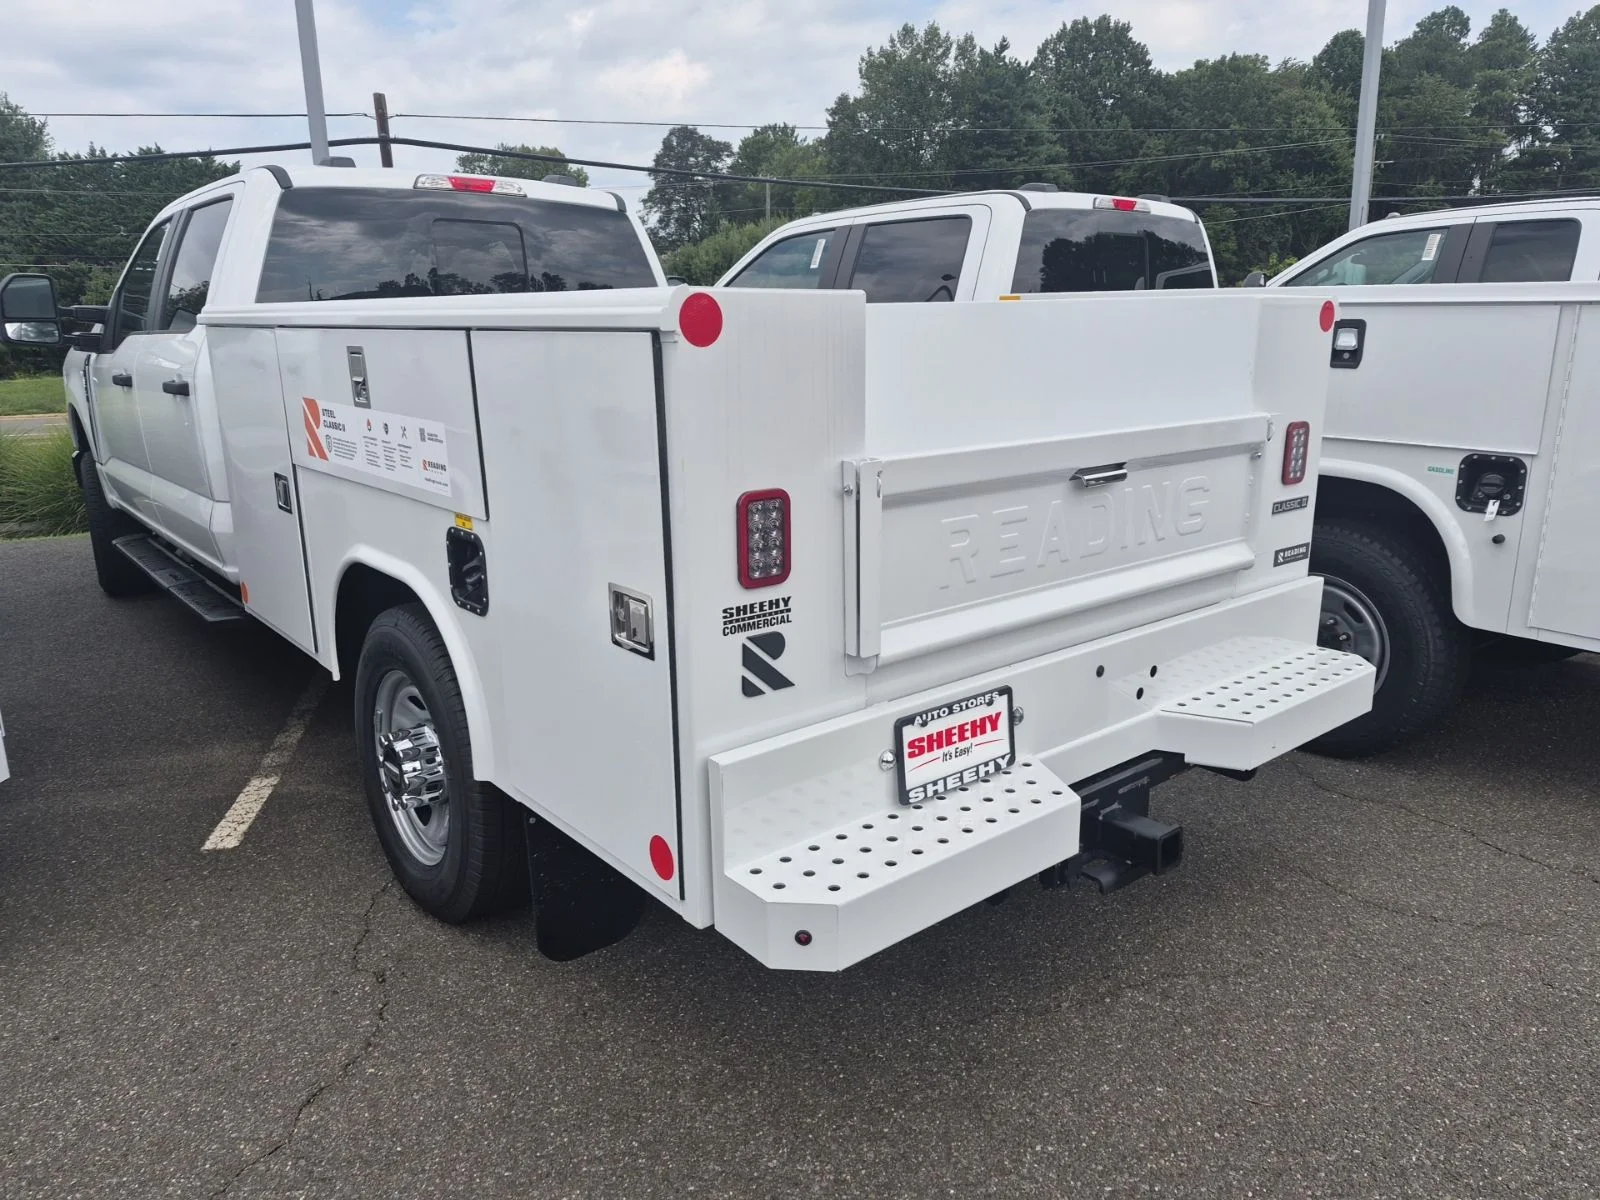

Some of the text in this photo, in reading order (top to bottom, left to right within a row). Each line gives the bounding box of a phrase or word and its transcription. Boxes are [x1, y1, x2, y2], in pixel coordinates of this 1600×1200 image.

[322, 408, 336, 419] STEEL
[323, 420, 342, 431] CLASSIC
[428, 460, 447, 472] READING
[1427, 465, 1454, 474] GASOLINE
[1273, 500, 1301, 513] CLASSIC
[939, 476, 1210, 590] READING
[1284, 546, 1307, 558] READING
[722, 596, 792, 619] SHEEHY
[722, 614, 792, 636] COMMERCIAL
[913, 707, 949, 726] AUTO
[907, 711, 1002, 759] SHEEHY
[942, 743, 973, 762] It's Easy!
[908, 754, 1012, 803] SHEEHY
